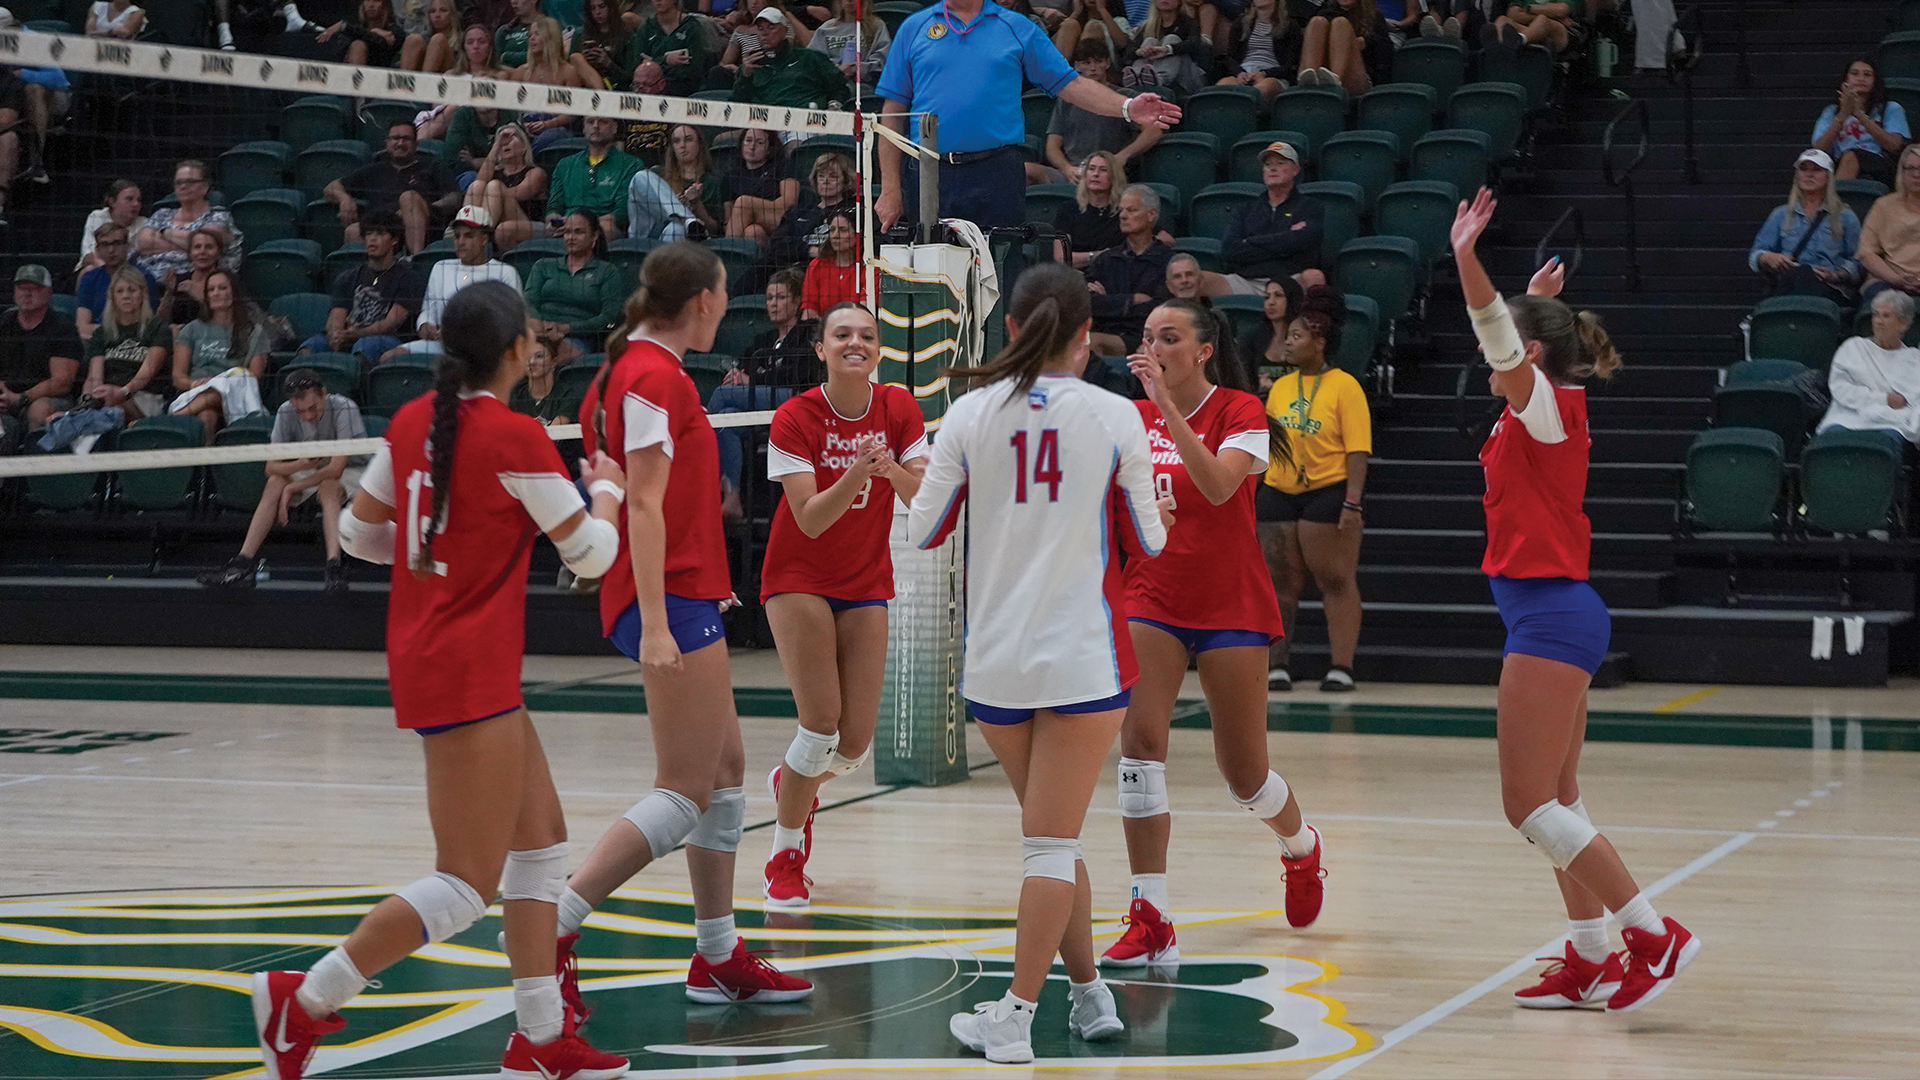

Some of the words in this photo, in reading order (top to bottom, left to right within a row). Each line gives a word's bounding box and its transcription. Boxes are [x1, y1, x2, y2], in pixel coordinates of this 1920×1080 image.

[96, 42, 131, 65] LIONS
[201, 54, 233, 75] LIONS
[297, 64, 329, 85] LIONS
[387, 72, 416, 92] LIONS
[470, 81, 497, 99] LIONS
[547, 88, 573, 106] LIONS
[619, 95, 642, 112] LIONS
[686, 101, 708, 118] LIONS
[749, 106, 769, 122] LIONS
[1010, 428, 1063, 504] 14
[947, 528, 956, 641] INT
[946, 653, 956, 764] LEO
